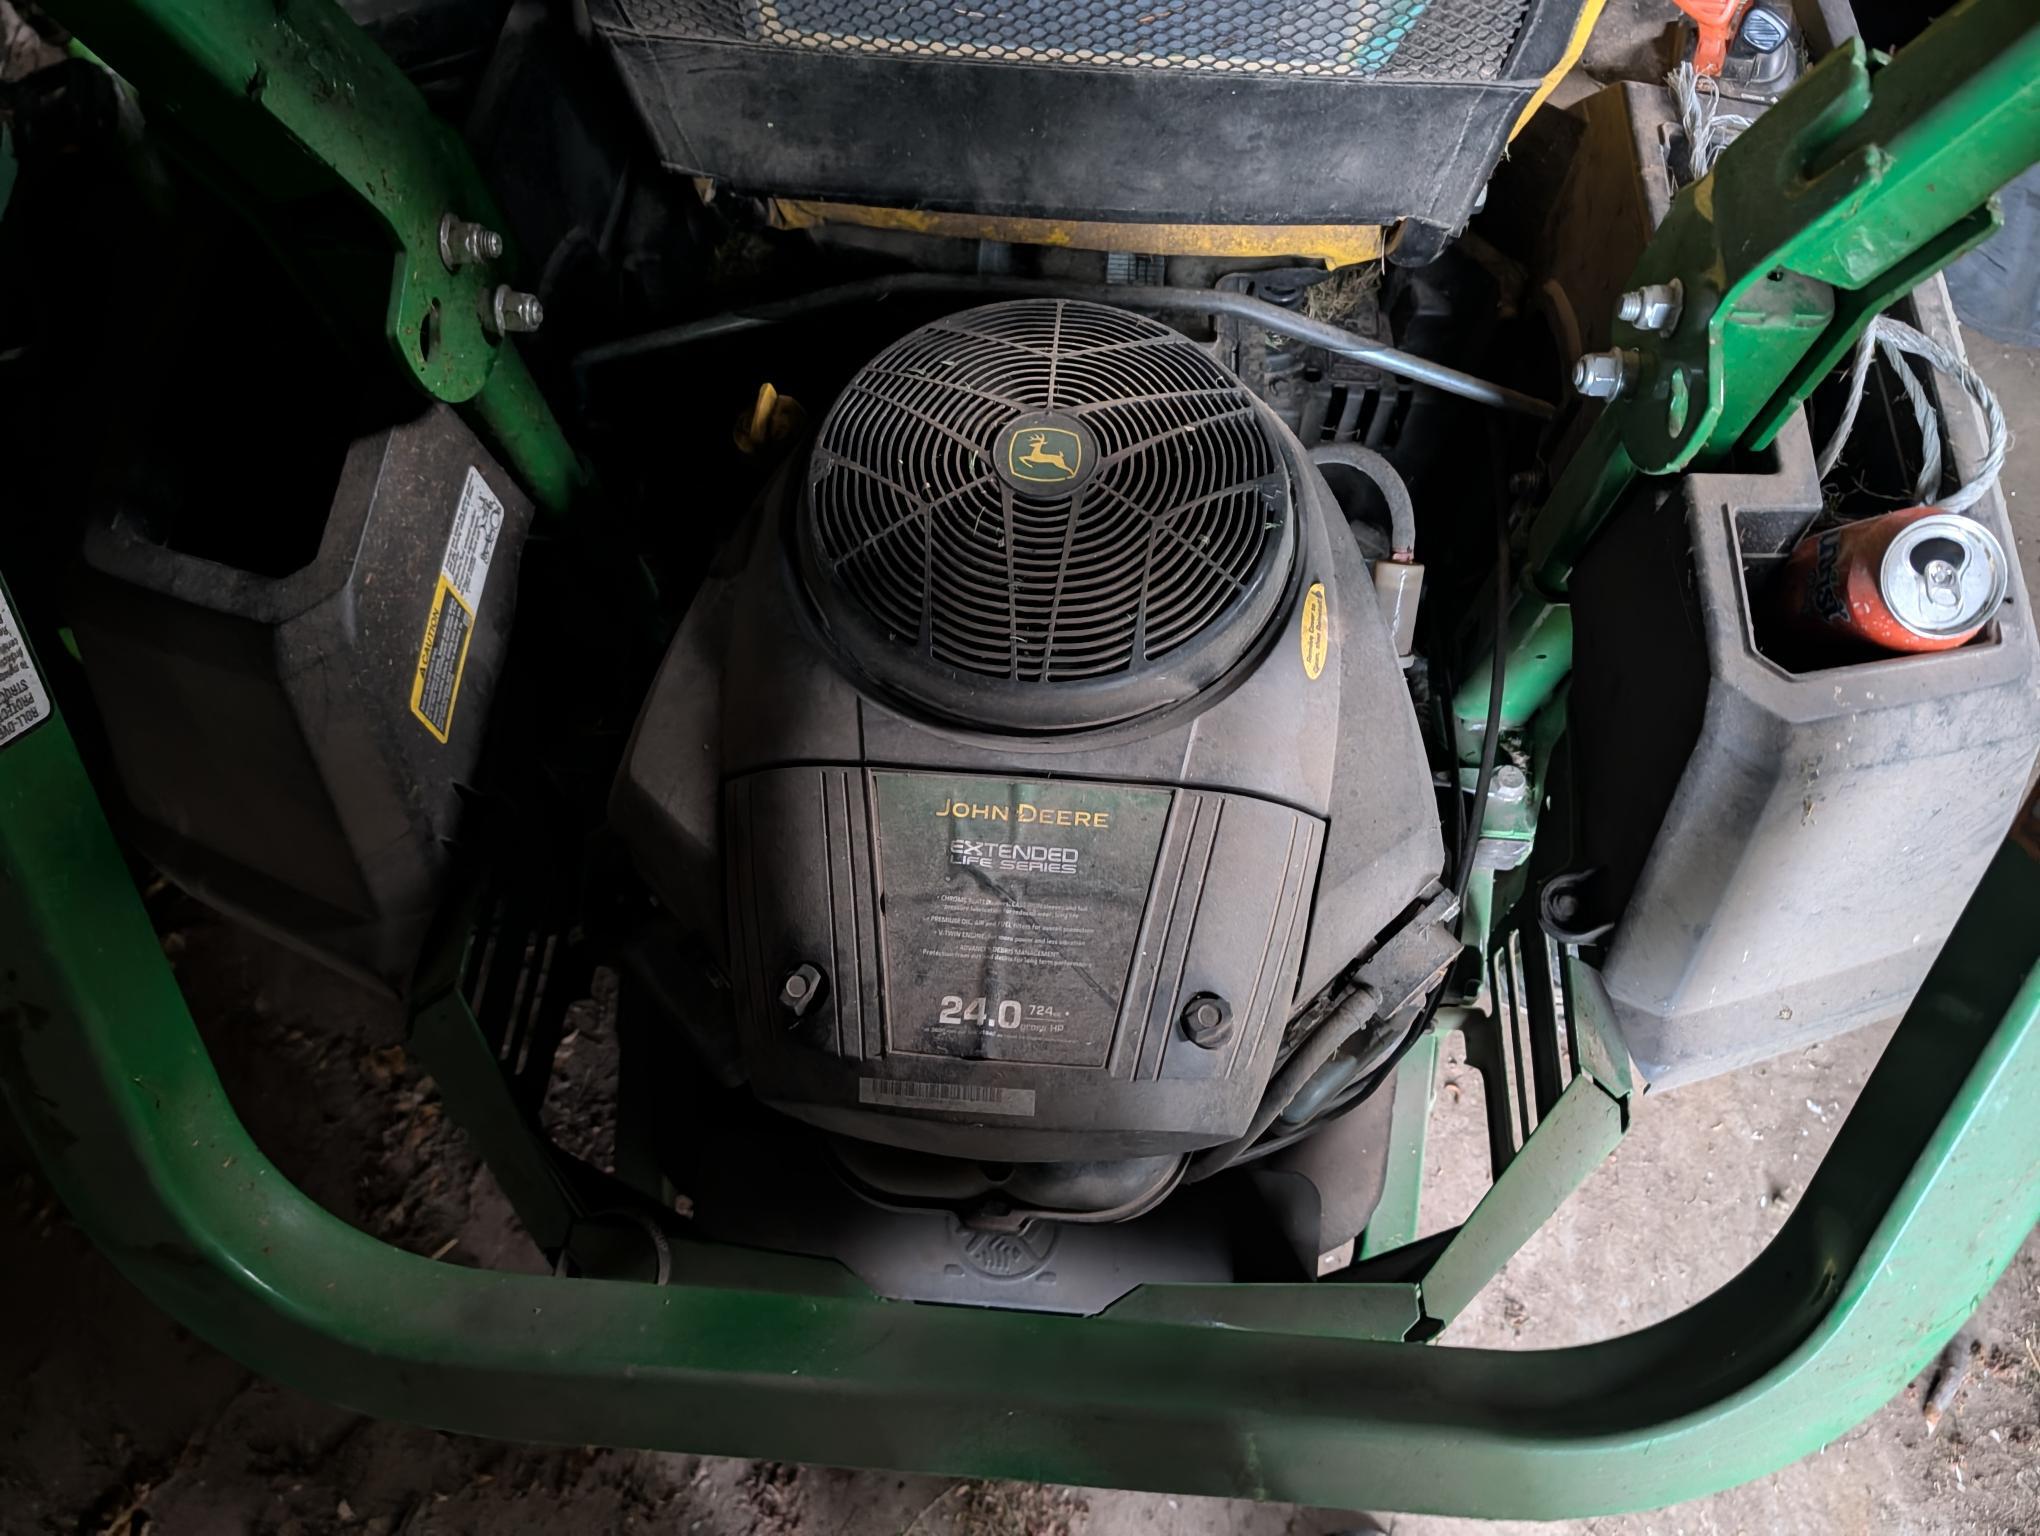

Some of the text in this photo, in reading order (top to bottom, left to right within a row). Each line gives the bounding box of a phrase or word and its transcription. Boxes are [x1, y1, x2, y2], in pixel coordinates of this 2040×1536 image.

[422, 608, 439, 664] CAUTION
[936, 799, 1110, 828] JOHN DEERE
[951, 839, 1078, 864] EXTENDED
[951, 853, 1077, 875] LIFE SERIES
[939, 995, 1022, 1029] 24.0
